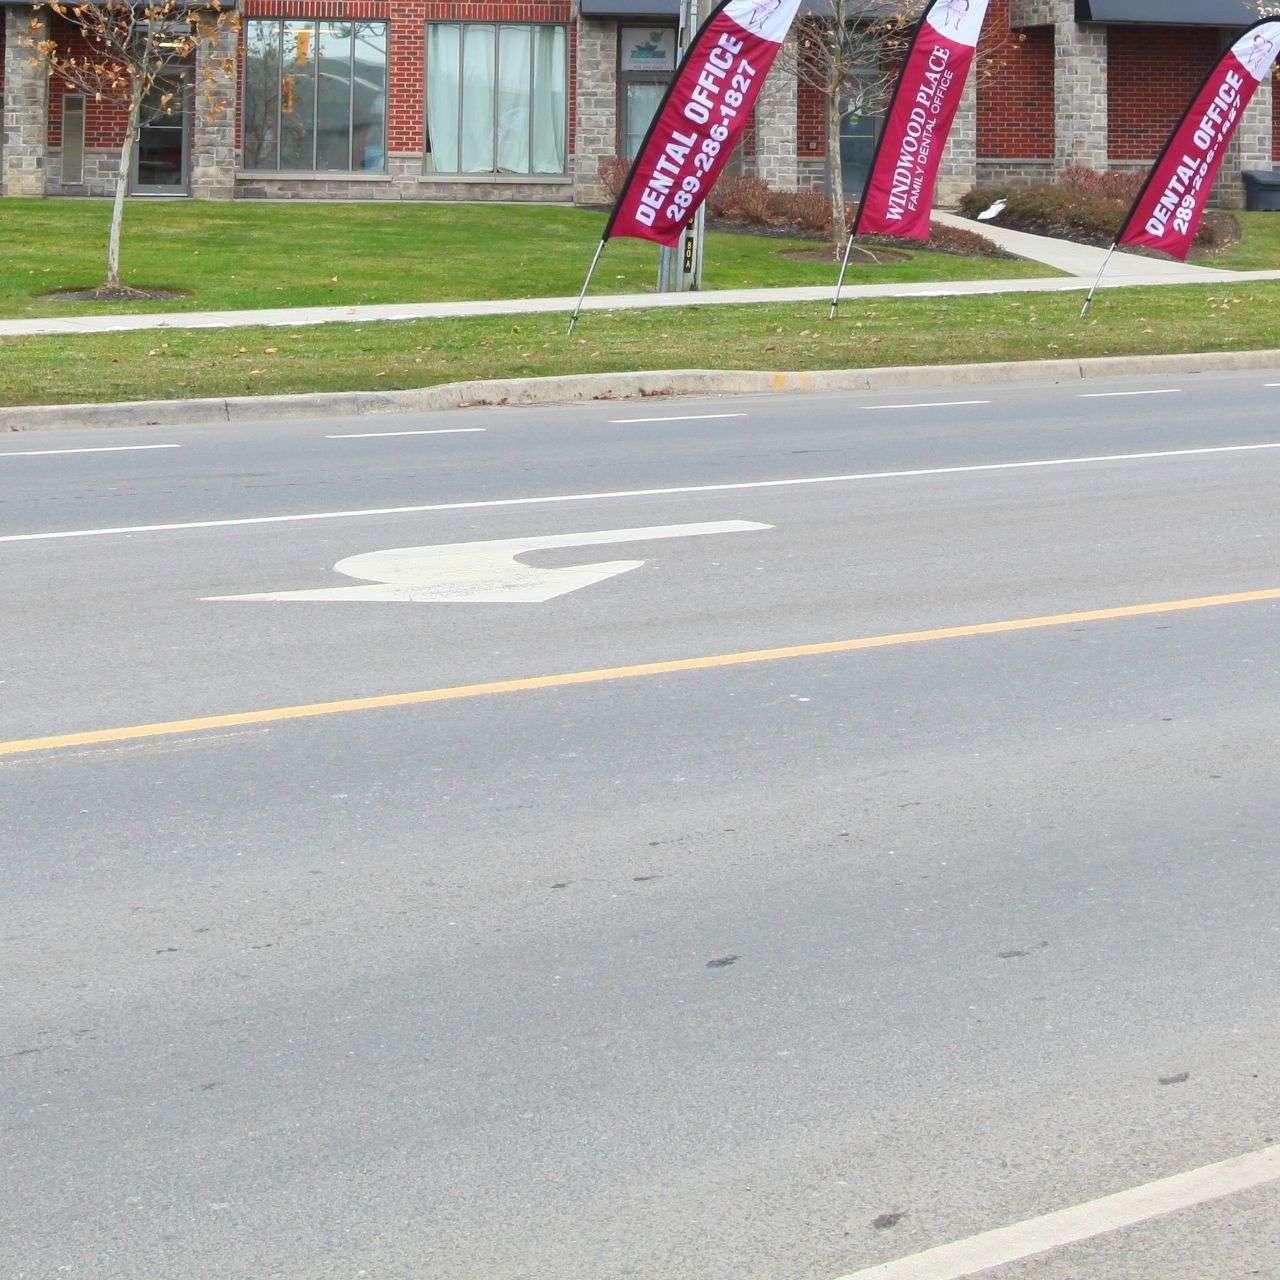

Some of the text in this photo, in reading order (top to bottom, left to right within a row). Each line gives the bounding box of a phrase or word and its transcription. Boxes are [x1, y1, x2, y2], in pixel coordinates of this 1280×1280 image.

[635, 130, 698, 227] DENTAL
[684, 32, 744, 126] OFFICE
[666, 59, 757, 223] 289-286-1827
[886, 45, 950, 221] WINDWOOD PLACE
[908, 70, 954, 212] FAMILY DENTAL OFFICE
[1145, 70, 1244, 237] DENTAL OFFICE
